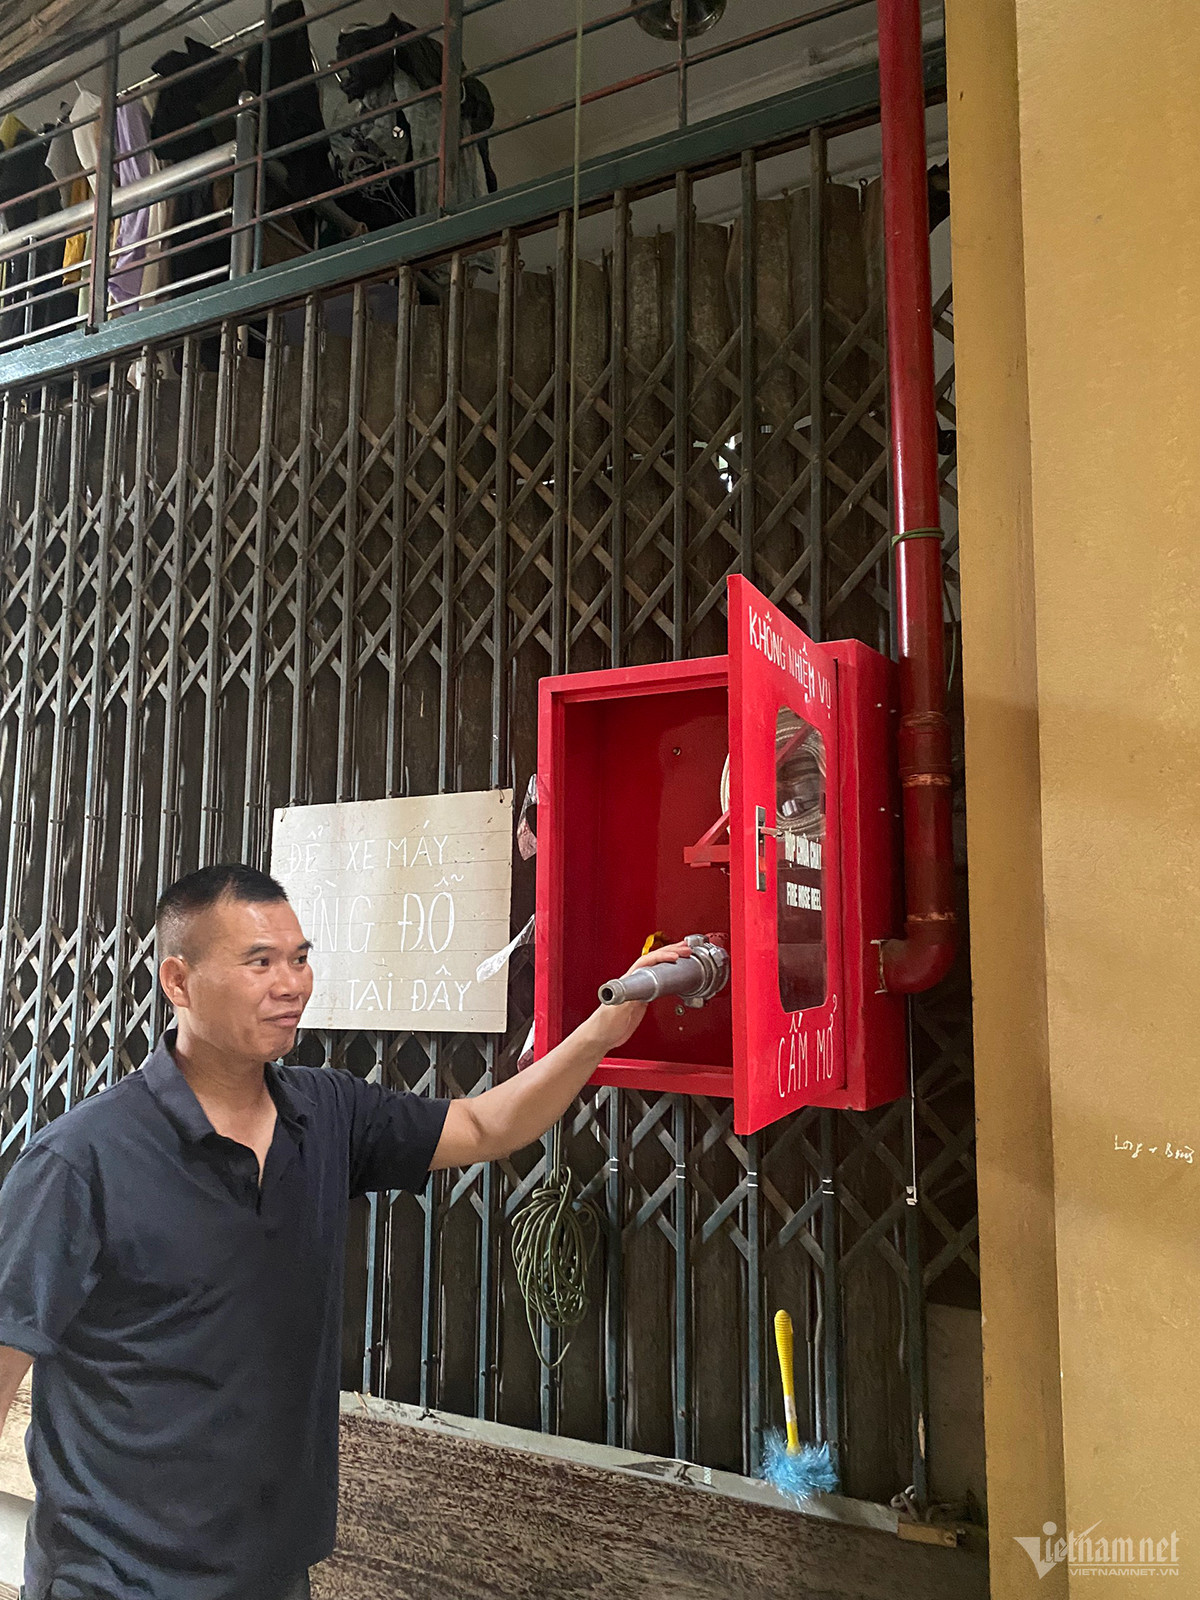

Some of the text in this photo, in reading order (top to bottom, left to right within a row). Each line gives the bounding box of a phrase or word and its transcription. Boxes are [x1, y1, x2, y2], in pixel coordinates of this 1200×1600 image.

[748, 605, 831, 719] KHÔNG NHIỆM VỤ
[286, 819, 448, 873] ĐỂ XE MÁY
[397, 873, 464, 954] ĐỖ
[346, 964, 472, 1011] TẠI ĐÂY
[778, 993, 837, 1098] CẤM MỞ
